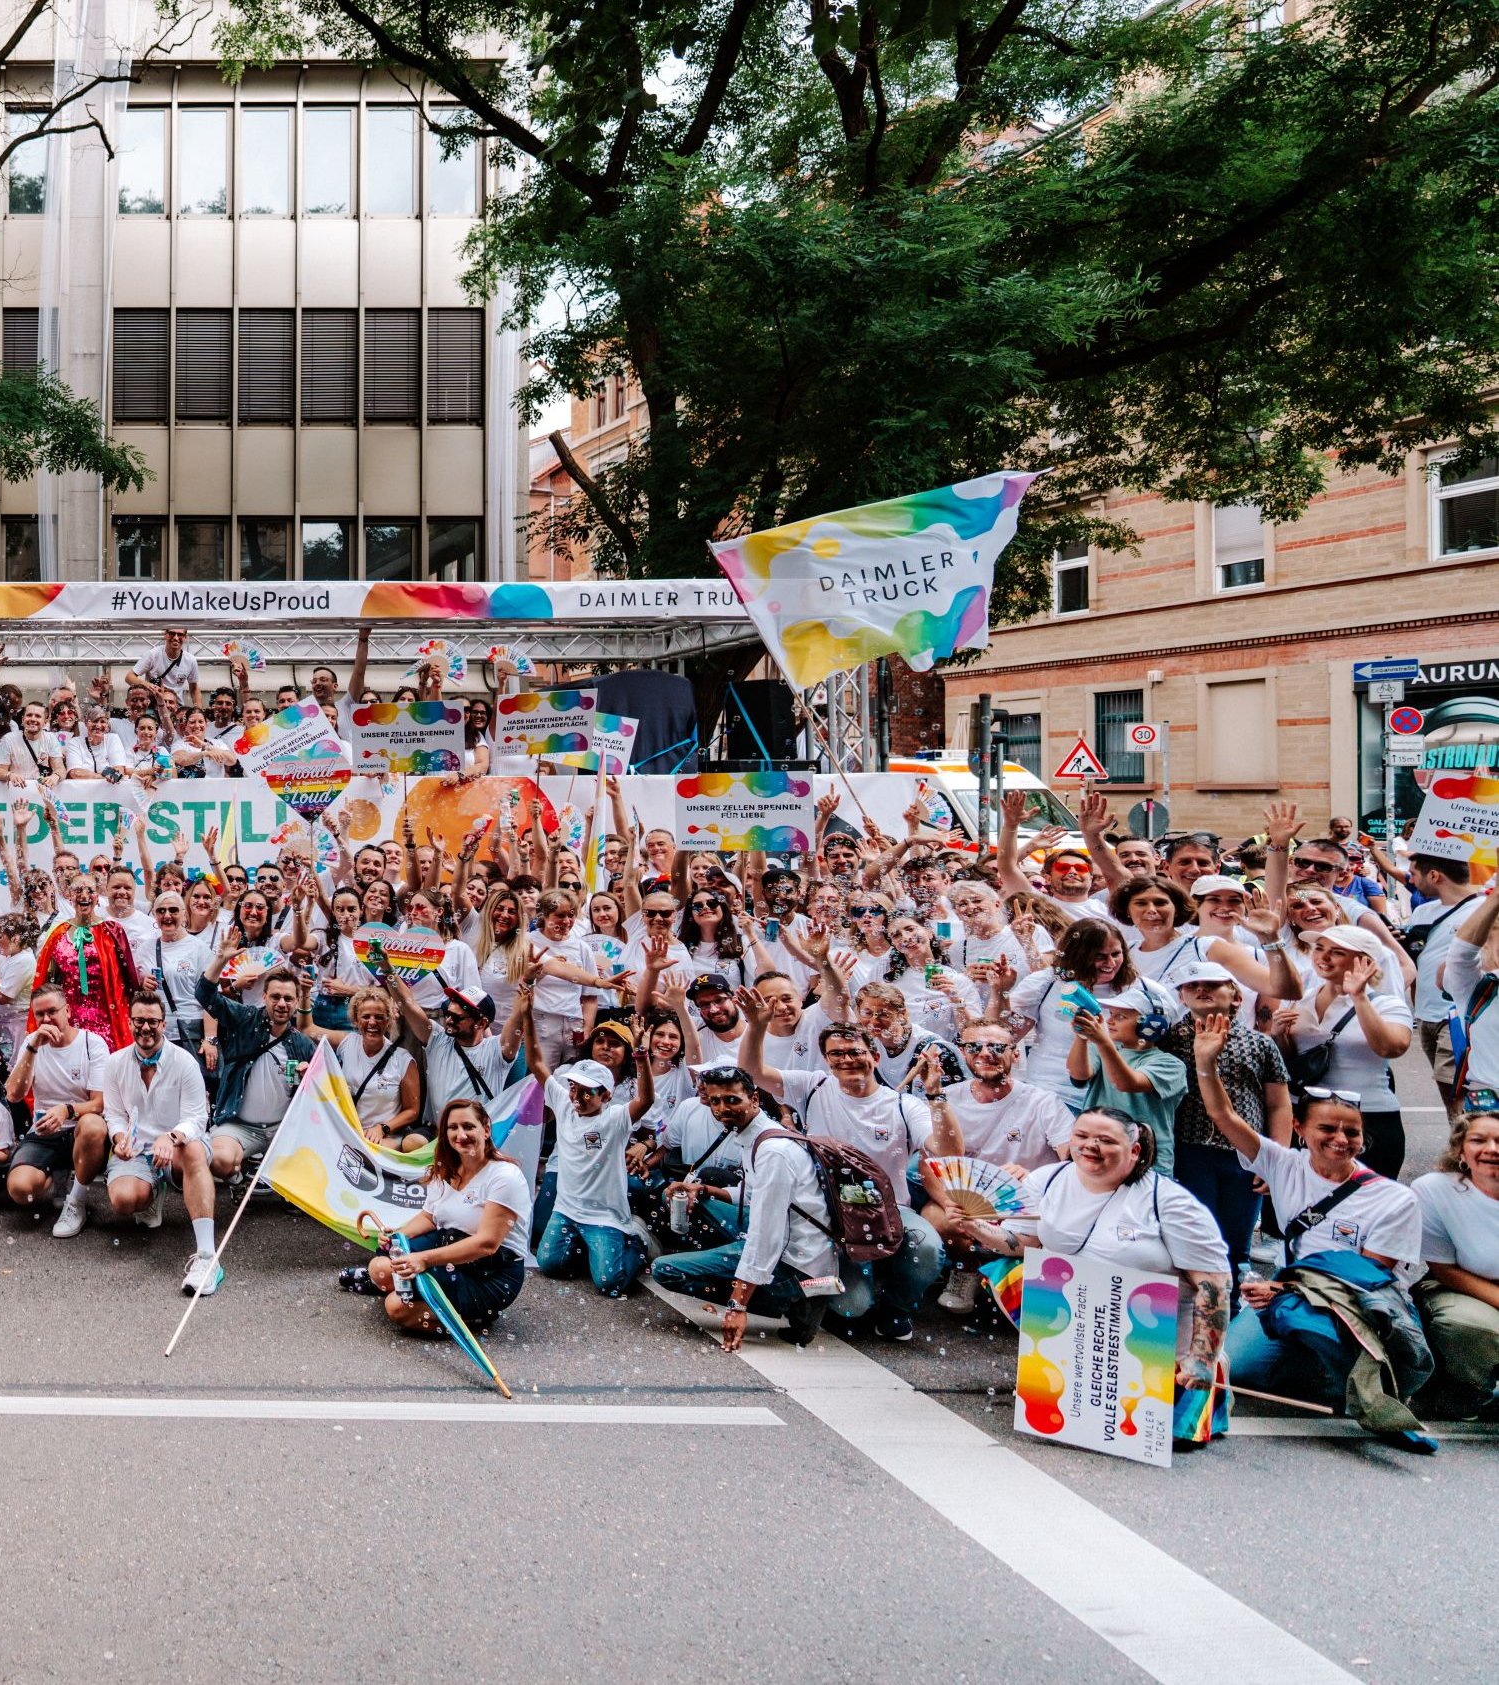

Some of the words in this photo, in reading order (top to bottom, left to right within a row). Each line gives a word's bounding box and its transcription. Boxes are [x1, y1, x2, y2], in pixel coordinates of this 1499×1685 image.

[819, 552, 954, 592] DAIMLER
[111, 590, 330, 611] #YouMakeUsProud
[580, 592, 679, 607] DAIMLER
[694, 591, 743, 606] TRU
[844, 576, 938, 605] TRUCK
[361, 731, 389, 739] UNSERE
[516, 723, 546, 731] UNSERER
[547, 720, 588, 728] LADEFLÄCHE
[1136, 730, 1151, 740] 30
[263, 744, 288, 761] GLEICHE
[251, 761, 270, 773] VOLLE
[282, 760, 336, 780] Proud
[284, 781, 293, 794] &
[290, 785, 334, 805] Loud
[721, 811, 738, 819] FÜR
[1451, 802, 1488, 815] Unsere
[1429, 818, 1468, 831] VOLLE
[1415, 837, 1462, 851] DAIMLER
[1422, 844, 1452, 855] TRUCK
[696, 975, 709, 985] M
[1074, 1283, 1088, 1321] Fracht:
[1093, 1304, 1108, 1354] RECHTE,
[1105, 1275, 1123, 1403] SELBSTBESTIMMUNG
[1073, 1320, 1086, 1378] wertvollste
[1090, 1354, 1105, 1407] GLEICHE
[1070, 1379, 1083, 1418] Unsere
[1104, 1404, 1117, 1441] VOLLE
[1144, 1410, 1155, 1459] DAIMLER
[1154, 1419, 1166, 1453] TRUCK
